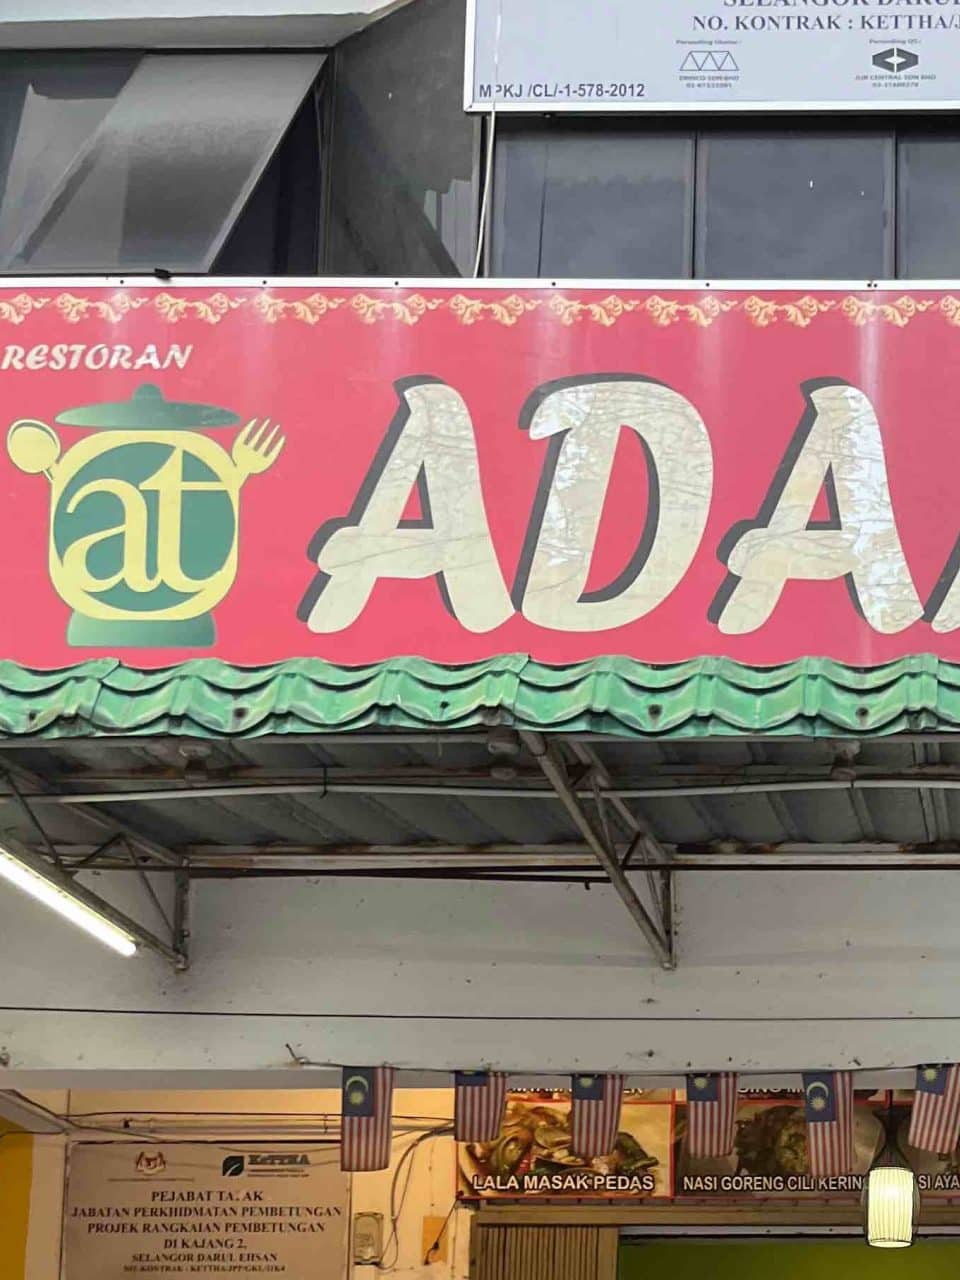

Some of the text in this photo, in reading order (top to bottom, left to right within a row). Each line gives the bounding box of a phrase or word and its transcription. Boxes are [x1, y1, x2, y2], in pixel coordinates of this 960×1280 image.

[692, 15, 728, 31] NO.
[735, 15, 841, 30] KONTRAK
[528, 83, 646, 98] /CL/-1-578-2012
[1, 343, 193, 370] RESTORAN
[473, 1174, 654, 1190] LALA MASAK PEDAS
[683, 1176, 717, 1190] NASI
[721, 1176, 784, 1190] GORENG
[787, 1176, 815, 1190] CILI
[151, 1190, 264, 1202] PEJABAT TAAK
[71, 1206, 342, 1218] JABATAN PERKHIDMATAN PEMBETUNGAN
[88, 1222, 326, 1234] PROJEK RANGKAIAN PEMBETUNGAN
[164, 1238, 178, 1249] DI
[181, 1238, 235, 1249] KAJANG
[131, 1253, 195, 1263] SELANGOR
[239, 1252, 278, 1262] EHSAN
